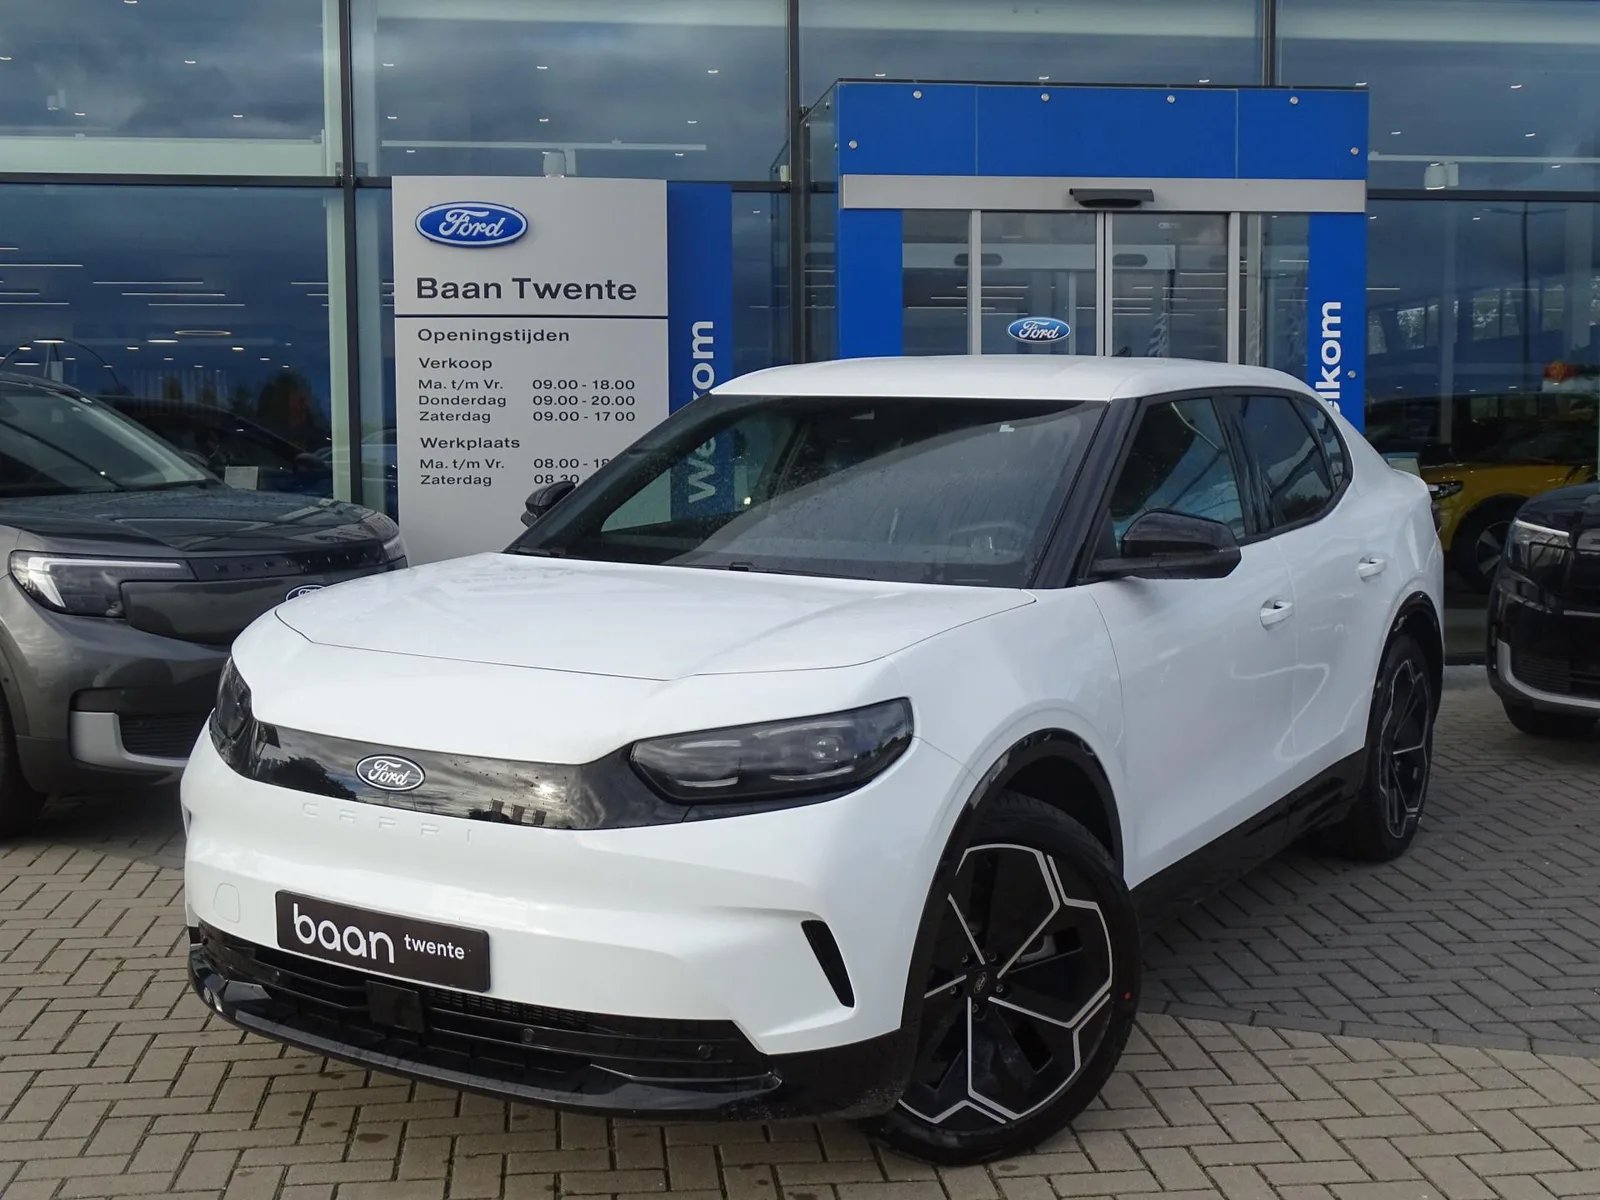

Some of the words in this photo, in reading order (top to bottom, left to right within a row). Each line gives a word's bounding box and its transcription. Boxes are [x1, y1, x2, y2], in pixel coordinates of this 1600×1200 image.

[438, 208, 506, 237] Ford
[416, 277, 502, 299] Baan
[511, 277, 637, 301] Twente
[417, 328, 570, 344] Openingstijden
[1018, 320, 1060, 339] Ford
[418, 357, 493, 371] Verkoop
[418, 379, 447, 389] Ma.
[451, 379, 479, 391] t/m
[483, 379, 503, 389] Vr.
[532, 379, 578, 390] 09.00
[592, 379, 635, 390] 18.00
[418, 395, 507, 408] Donderdag
[532, 395, 578, 406] 09.00
[591, 395, 635, 406] 20.00
[419, 411, 491, 424] Zaterdag
[533, 411, 580, 422] 09.00
[420, 437, 520, 450] Werkplaats
[419, 459, 448, 469] Ma.
[452, 459, 480, 470] t/m
[485, 459, 505, 469] Vr.
[533, 458, 580, 469] 08.00
[420, 475, 492, 487] Zaterdag
[368, 759, 410, 786] Ford
[302, 802, 472, 844] CAPRI
[293, 903, 395, 964] baan
[404, 933, 465, 960] twente
